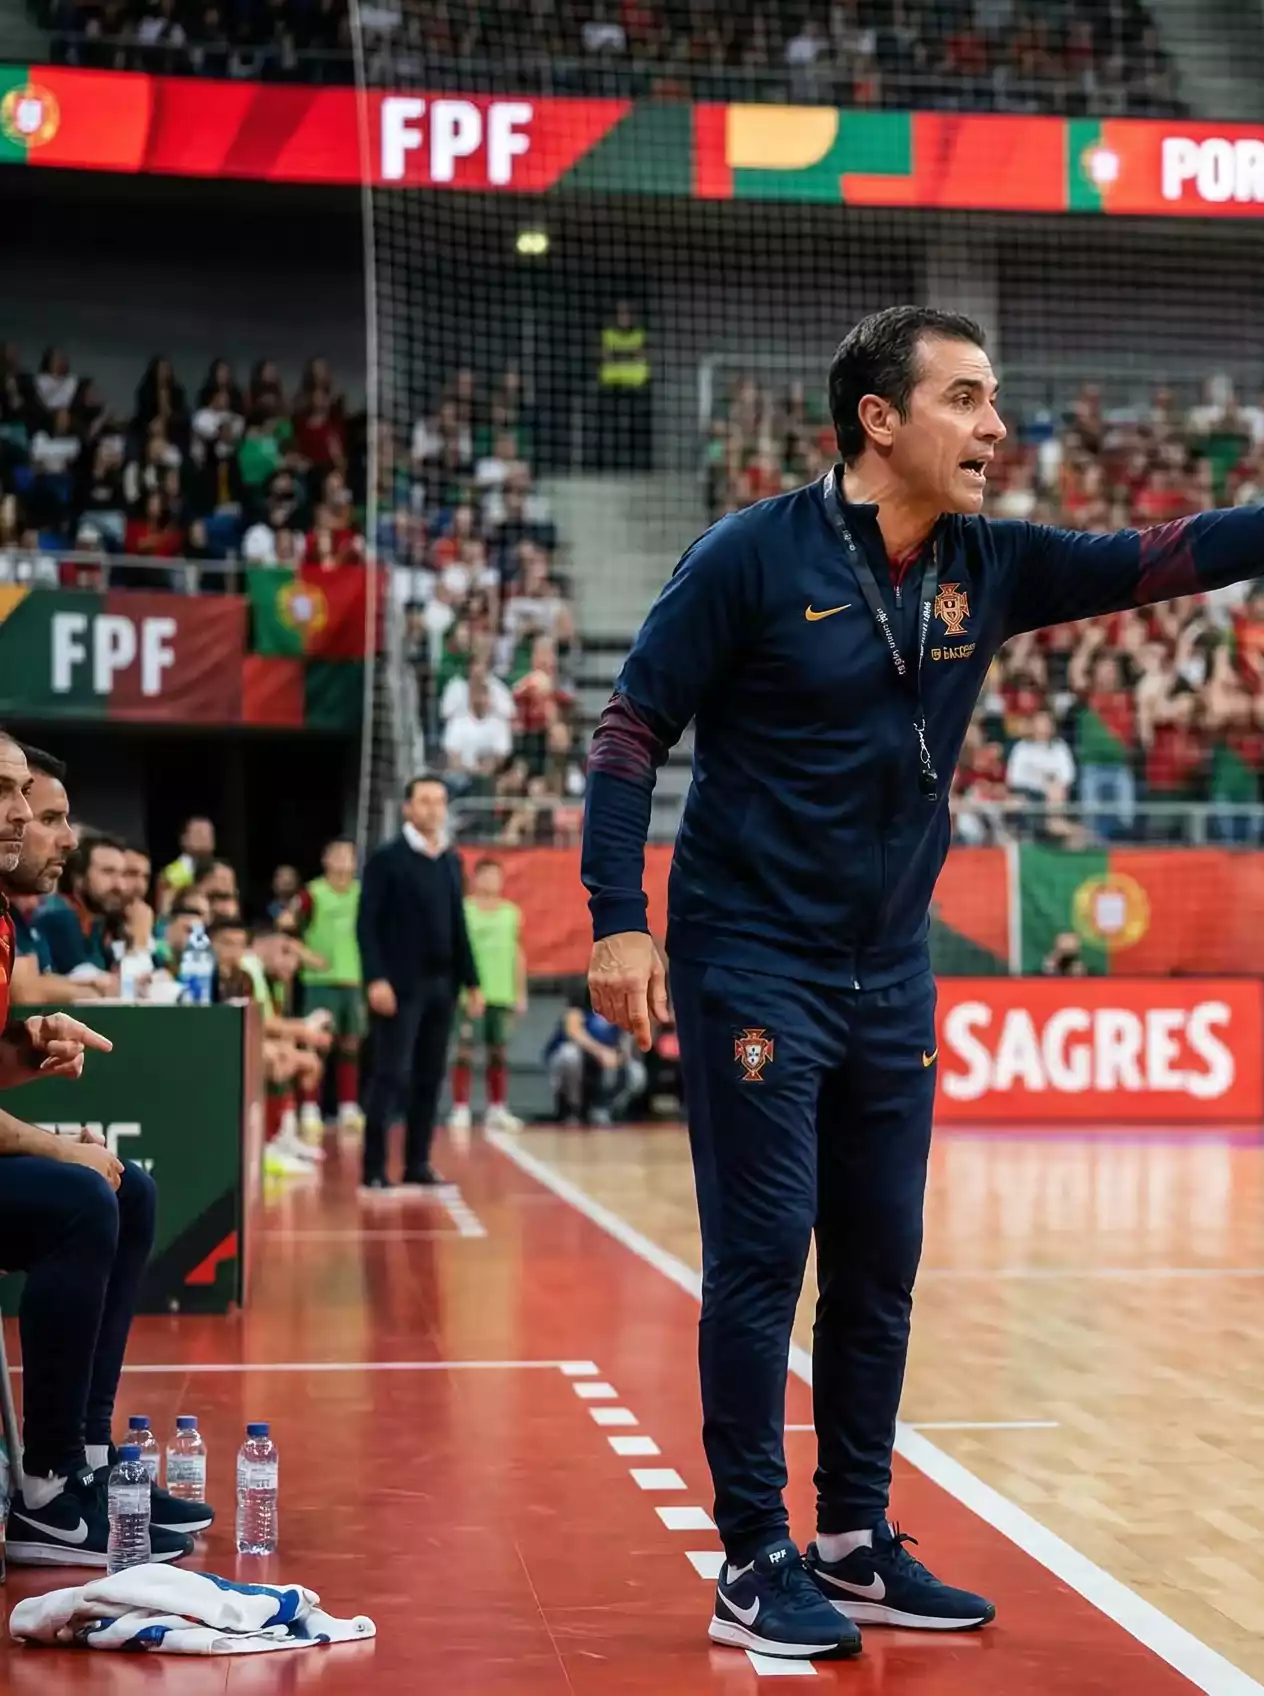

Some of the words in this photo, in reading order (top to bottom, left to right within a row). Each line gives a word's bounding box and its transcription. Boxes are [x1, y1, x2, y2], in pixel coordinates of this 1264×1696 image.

[380, 96, 534, 186] FPF
[51, 612, 178, 697] FPF
[941, 1000, 1235, 1101] SAGRES
